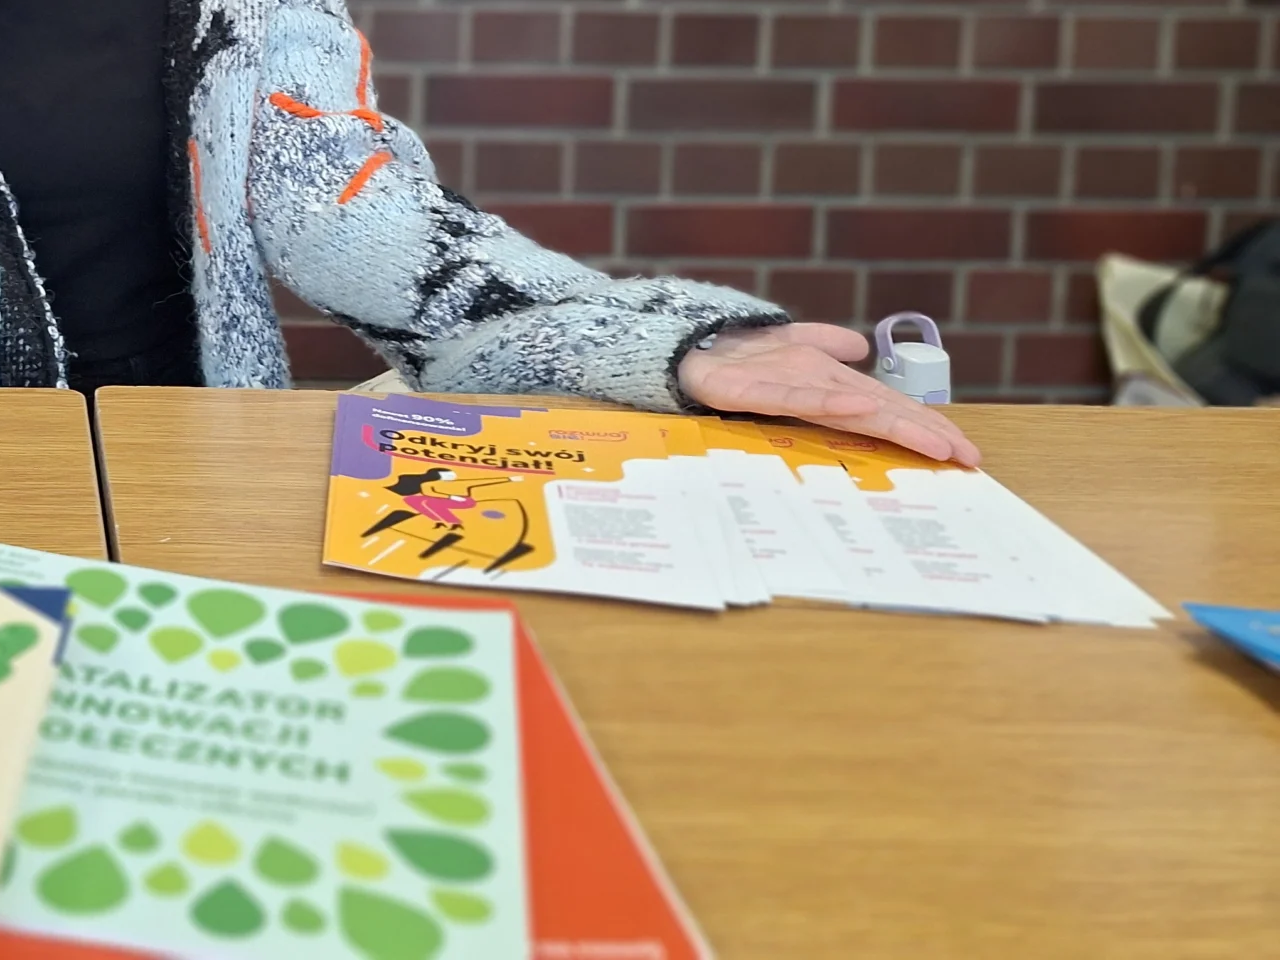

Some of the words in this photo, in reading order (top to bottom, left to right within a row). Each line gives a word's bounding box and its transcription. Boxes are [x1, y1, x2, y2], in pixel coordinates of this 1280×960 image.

[411, 414, 455, 426] 90%
[378, 442, 555, 470] potencjał!
[379, 429, 497, 456] Odkryj
[506, 447, 586, 463] swój
